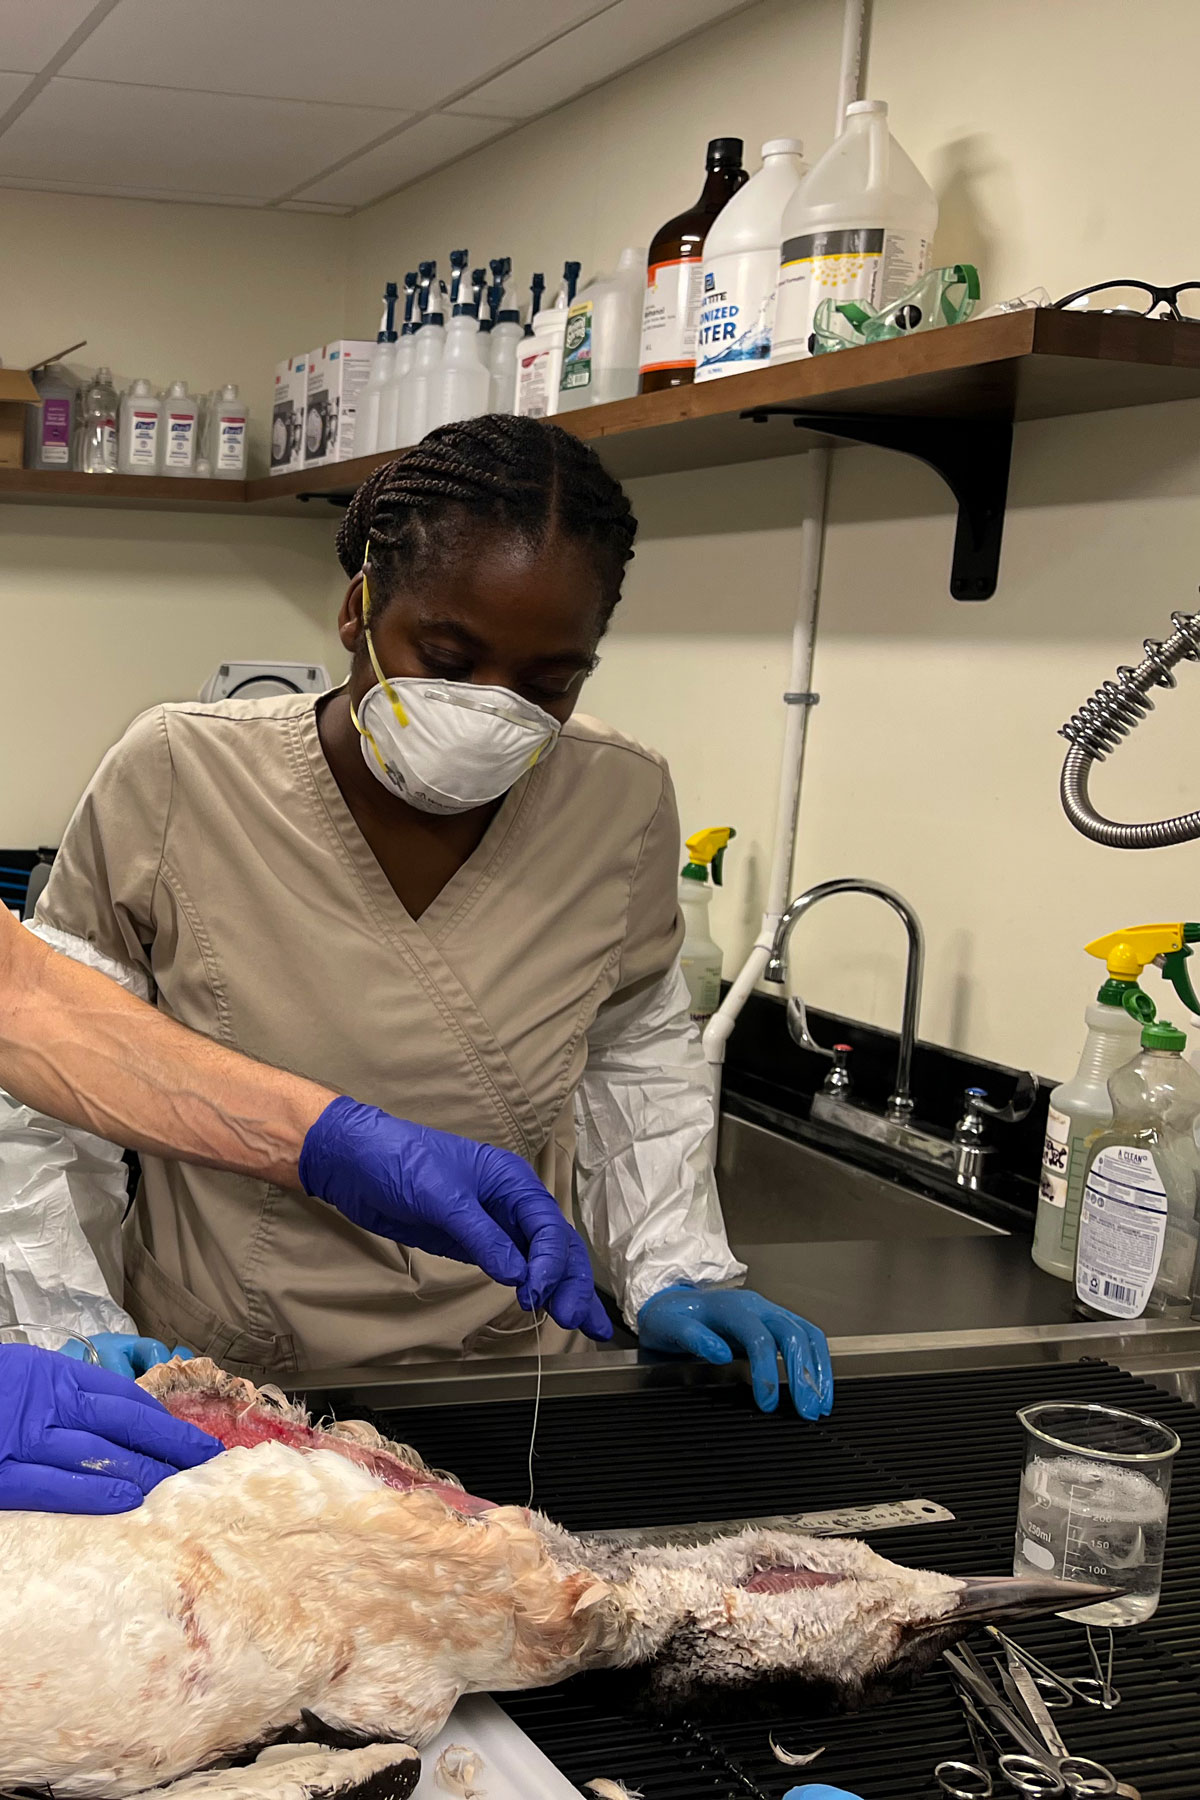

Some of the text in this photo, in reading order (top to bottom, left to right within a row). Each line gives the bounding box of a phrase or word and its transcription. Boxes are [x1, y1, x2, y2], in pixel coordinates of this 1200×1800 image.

[1092, 1514, 1112, 1523] 200
[1028, 1521, 1052, 1543] 250ml
[1090, 1539, 1110, 1549] 150
[1089, 1565, 1107, 1576] 100
